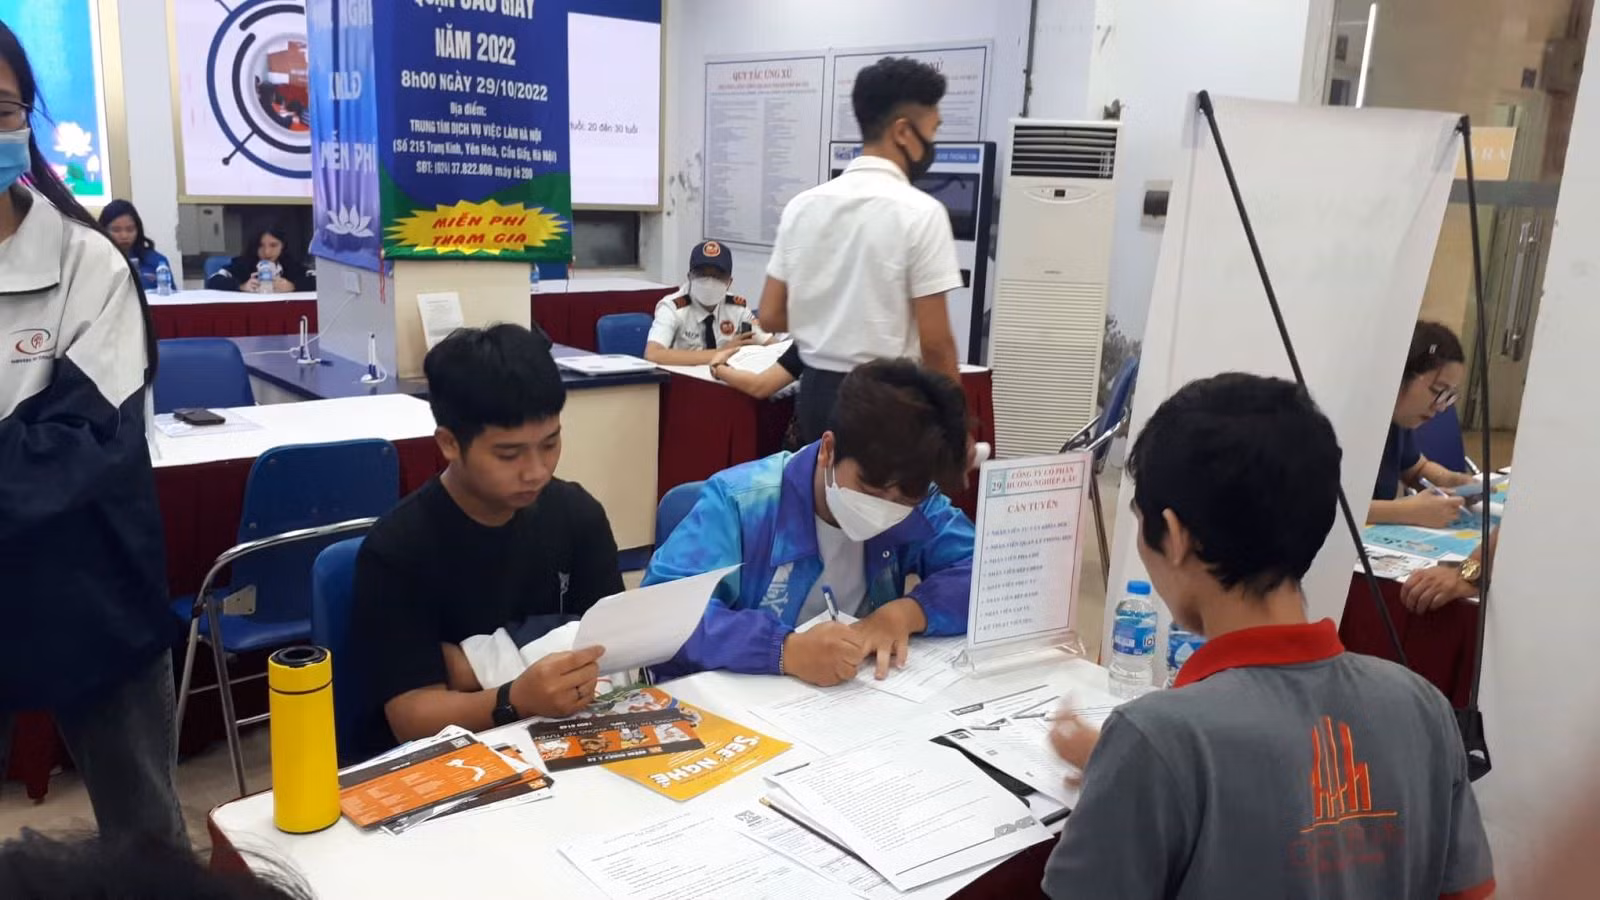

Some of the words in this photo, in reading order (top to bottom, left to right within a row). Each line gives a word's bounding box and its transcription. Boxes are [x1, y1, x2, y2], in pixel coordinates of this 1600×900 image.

[435, 23, 471, 60] NĂM
[476, 33, 516, 66] 2022
[401, 70, 436, 89] 8h00
[439, 70, 472, 92] NGÀY
[476, 77, 548, 101] 29/10/2022
[409, 119, 436, 133] TRUNG
[451, 121, 470, 137] DỊCH
[470, 123, 481, 138] VỤ
[482, 122, 502, 140] VIỆC
[588, 123, 597, 131] 20
[393, 138, 408, 154] (Số
[409, 140, 425, 153] 215
[426, 141, 445, 155] Trung
[432, 212, 483, 229] MIỄN
[489, 214, 527, 227] PHÍ
[432, 234, 485, 246] THAM
[493, 233, 528, 244] GIA
[991, 481, 1003, 492] 29
